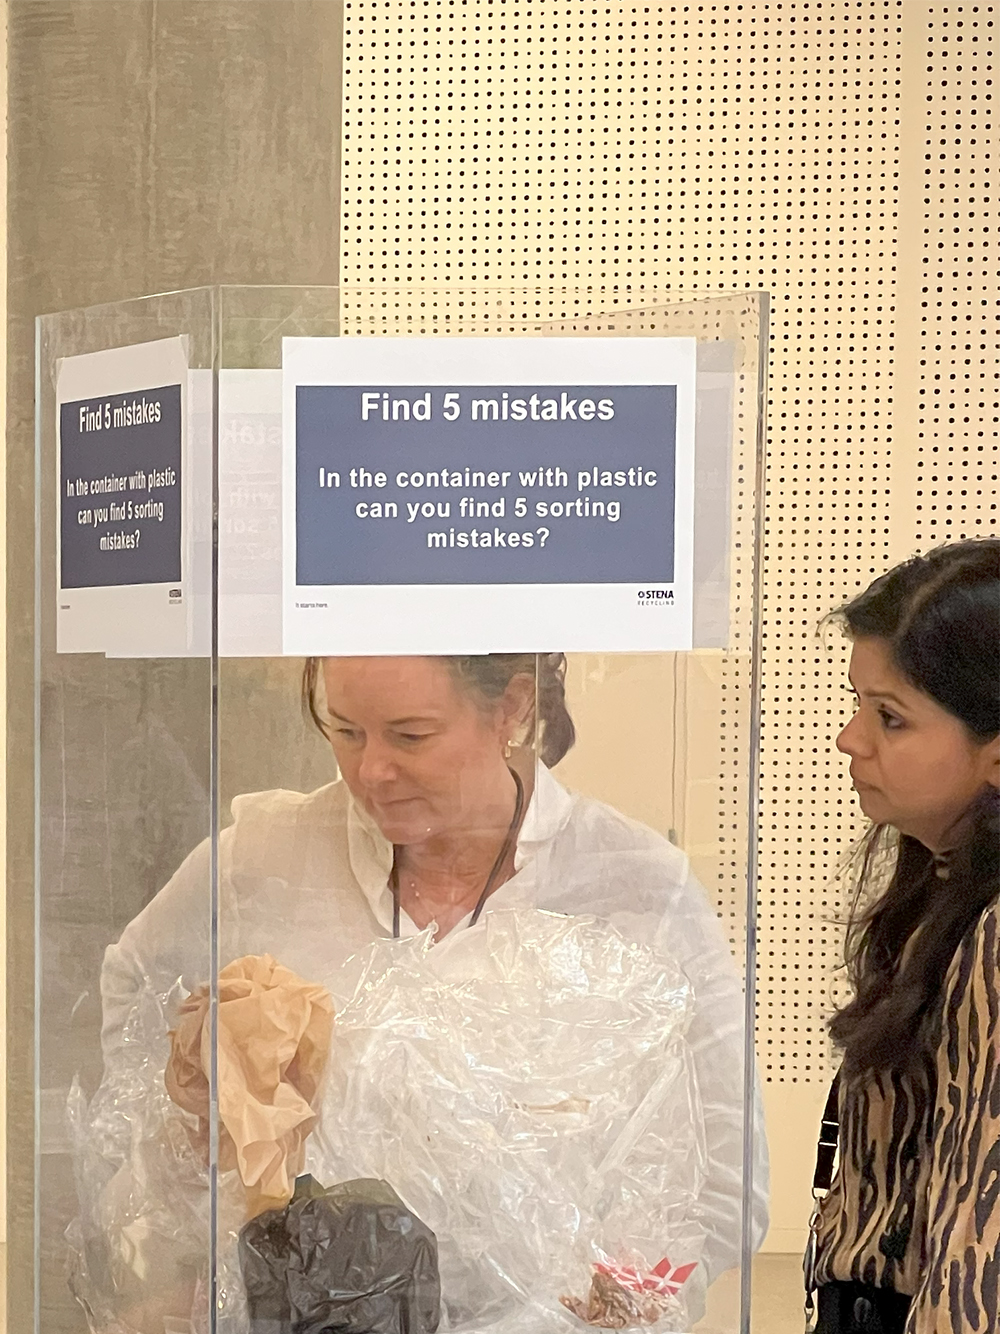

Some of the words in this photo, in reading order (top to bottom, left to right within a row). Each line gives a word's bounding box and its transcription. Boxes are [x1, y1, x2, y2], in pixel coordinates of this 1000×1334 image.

[79, 404, 102, 433] Find
[104, 403, 111, 430] 5
[114, 397, 162, 429] mistakes
[361, 392, 432, 421] Find
[443, 392, 461, 421] 5
[471, 392, 615, 421] mistakes
[67, 479, 75, 497] In
[76, 477, 88, 496] the
[90, 473, 128, 495] container
[128, 470, 146, 491] with
[148, 467, 176, 493] plastic
[319, 467, 341, 488] In
[349, 467, 387, 488] the
[396, 467, 511, 488] container
[518, 467, 568, 487] with
[577, 466, 658, 492] plastic
[77, 508, 92, 525] can
[93, 507, 109, 528] you
[110, 502, 126, 523] find
[127, 500, 133, 520] 5
[134, 499, 164, 522] sorting
[355, 502, 398, 518] can
[406, 502, 451, 523] you
[459, 497, 505, 518] find
[514, 497, 528, 518] 5
[535, 497, 622, 522] sorting
[100, 529, 141, 551] mistakes?
[427, 528, 550, 548] mistakes?
[646, 590, 674, 599] STENA
